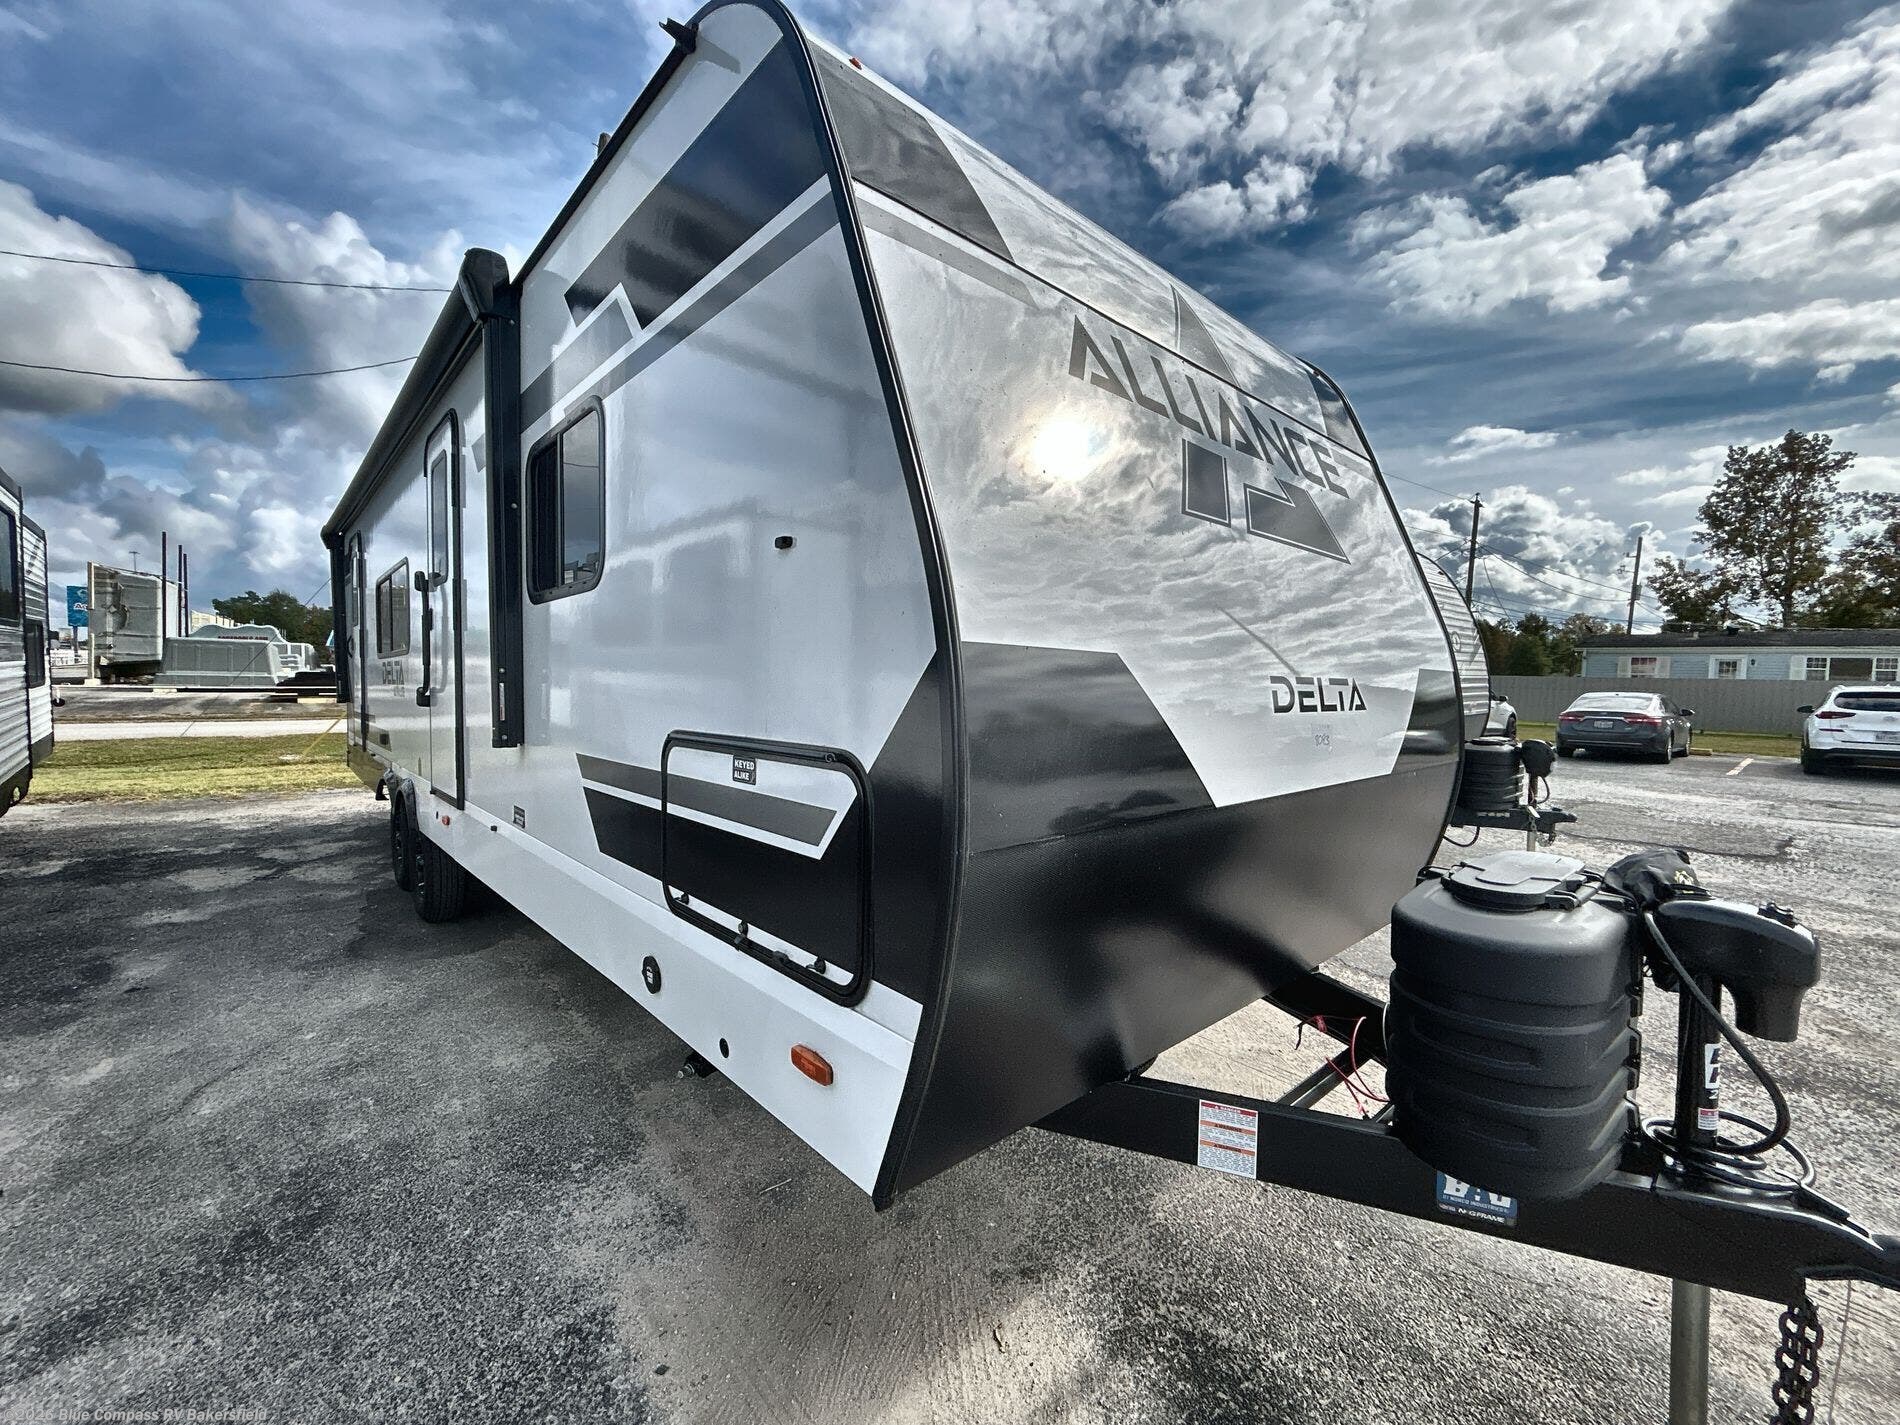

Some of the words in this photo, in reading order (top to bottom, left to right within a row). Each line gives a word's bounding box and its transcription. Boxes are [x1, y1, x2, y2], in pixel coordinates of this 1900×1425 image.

[1069, 315, 1350, 499] ALLIANCE
[1269, 675, 1367, 713] DELTA
[734, 759, 755, 770] KEYED
[734, 770, 750, 781] ALIKE
